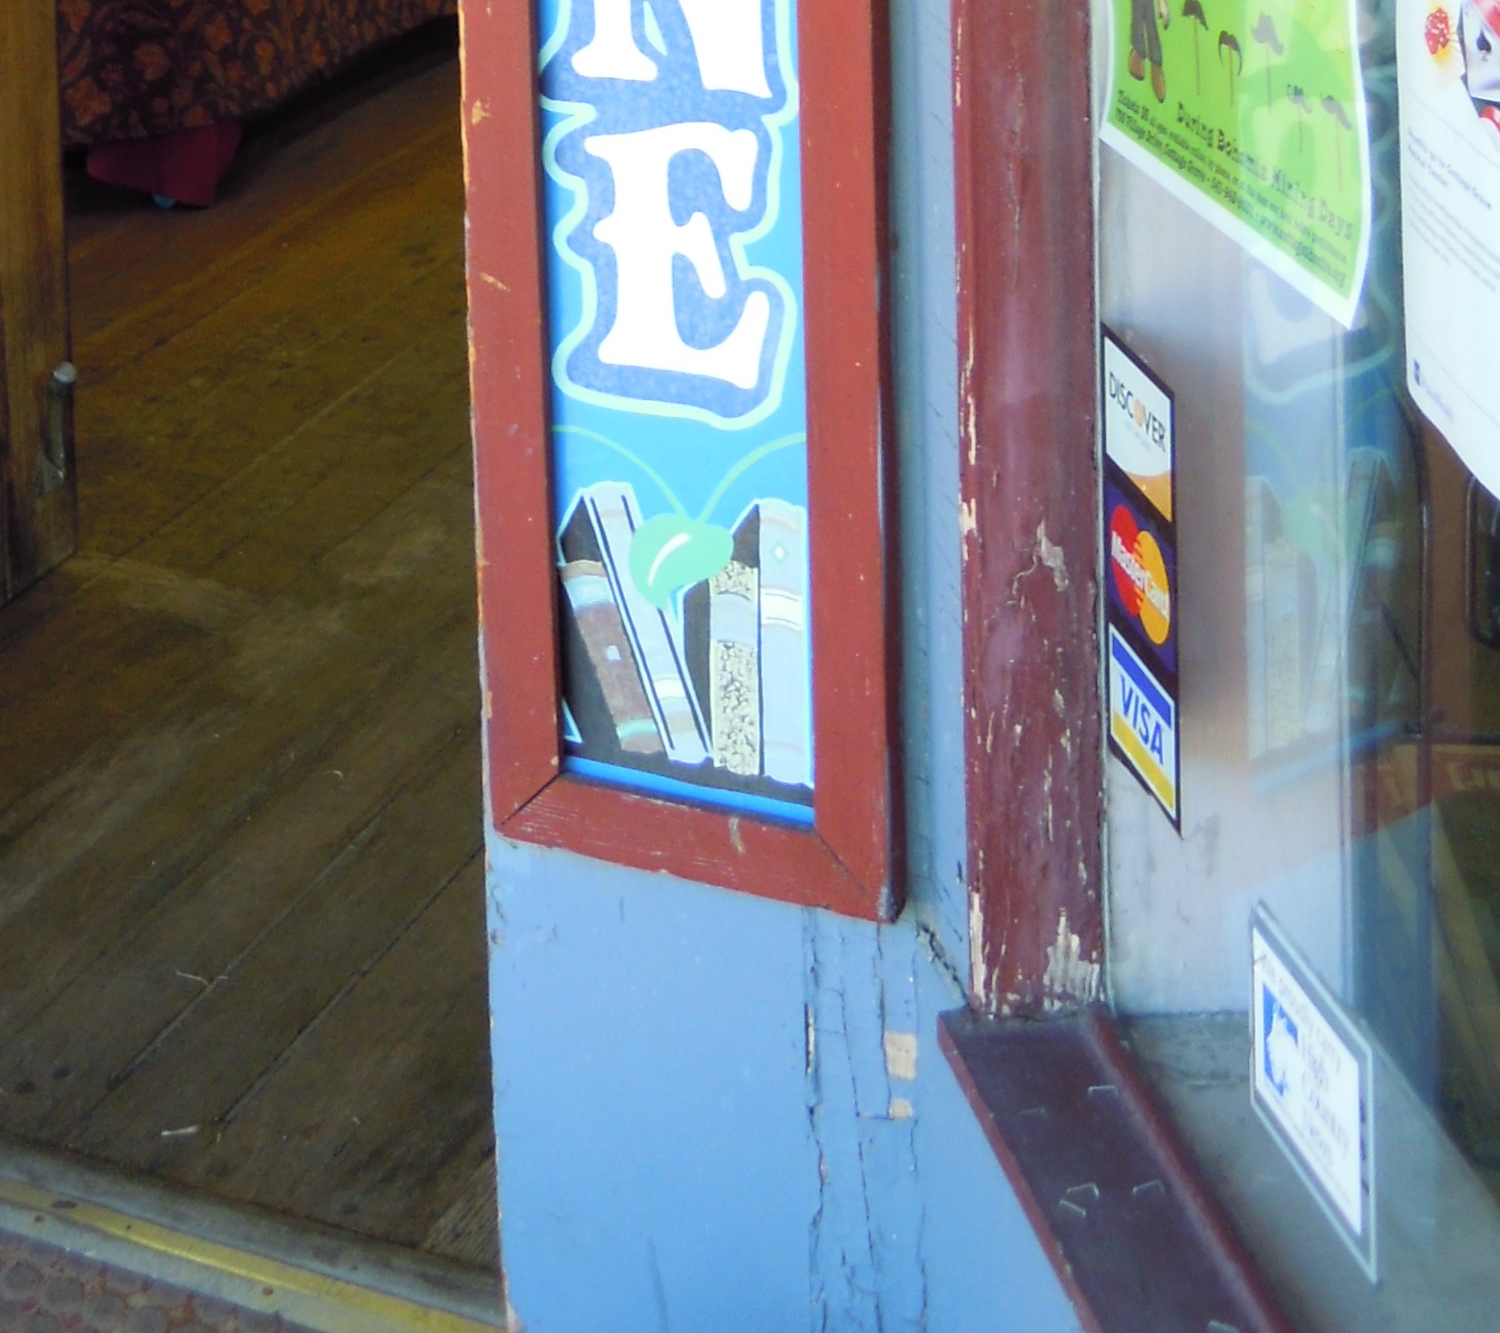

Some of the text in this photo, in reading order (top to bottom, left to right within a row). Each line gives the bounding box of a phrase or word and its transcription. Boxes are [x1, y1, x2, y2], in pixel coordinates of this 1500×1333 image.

[1108, 370, 1166, 453] DISCOVER
[1110, 531, 1170, 619] MasterCard
[1120, 674, 1165, 765] VISA
